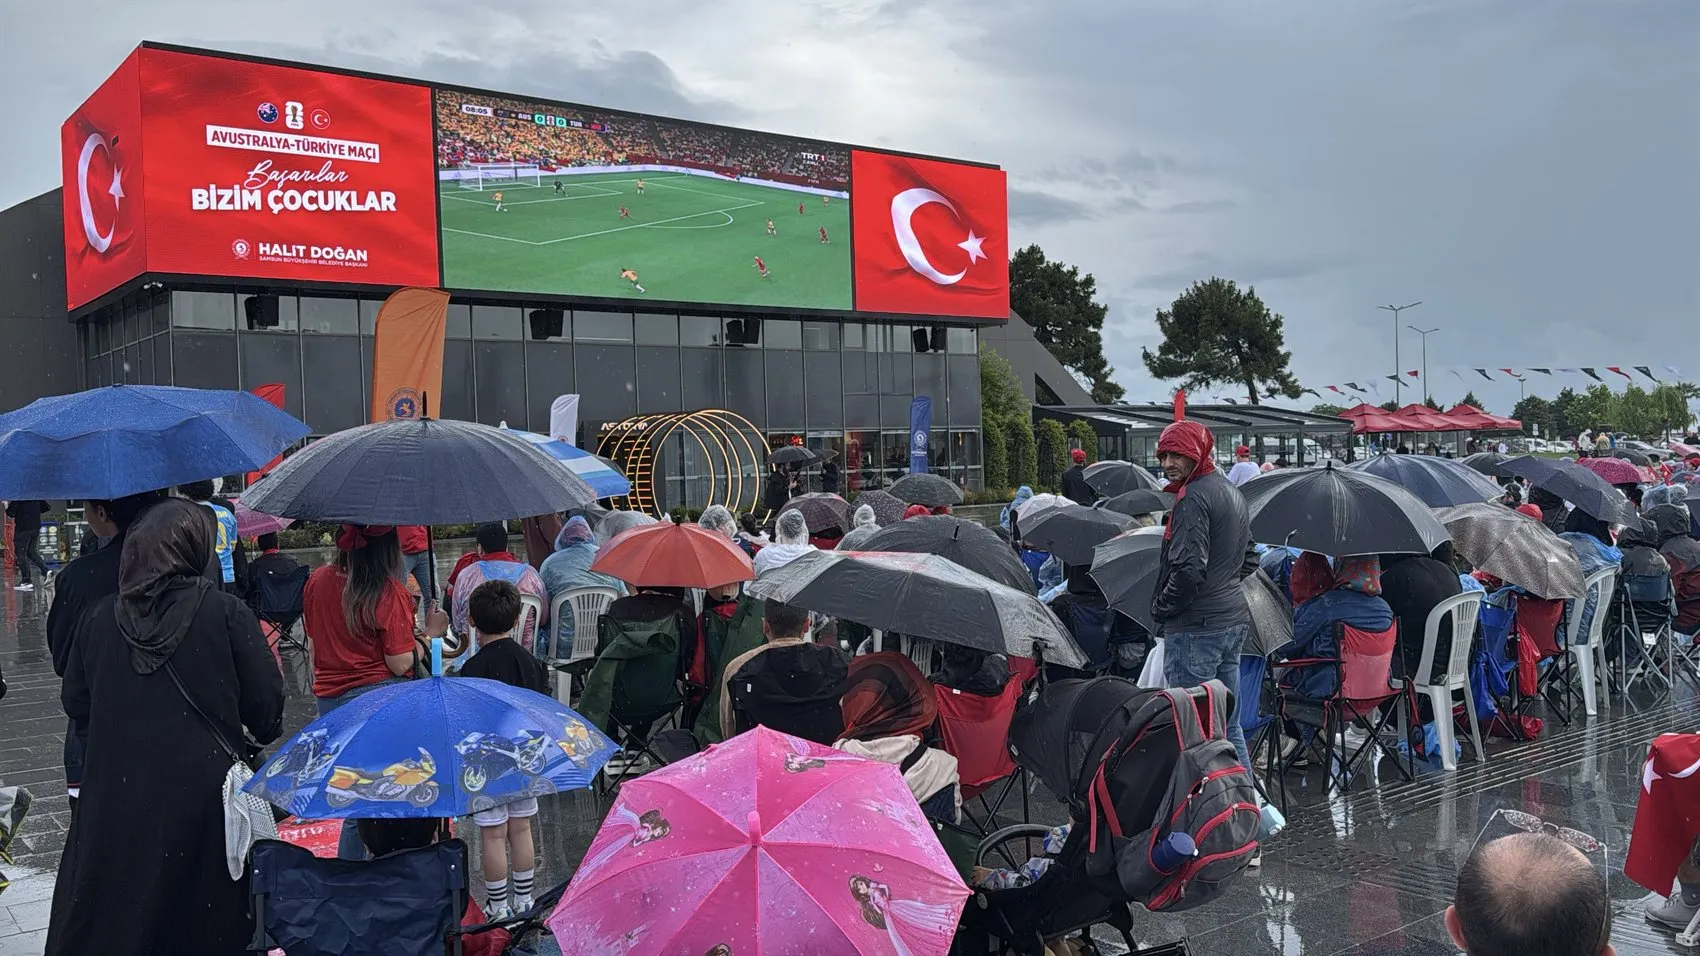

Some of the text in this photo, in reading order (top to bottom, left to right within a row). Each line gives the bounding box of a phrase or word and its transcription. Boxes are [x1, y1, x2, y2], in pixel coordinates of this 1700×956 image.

[465, 106, 488, 115] 08:05
[517, 113, 532, 121] AUS
[211, 130, 377, 161] AVUSTRALYA-TÜRKİYE MAÇI
[801, 152, 820, 161] TRT
[243, 159, 349, 189] Başarılar
[191, 184, 397, 215] BİZİM ÇOCUKLAR
[310, 246, 367, 262] DOĞAN
